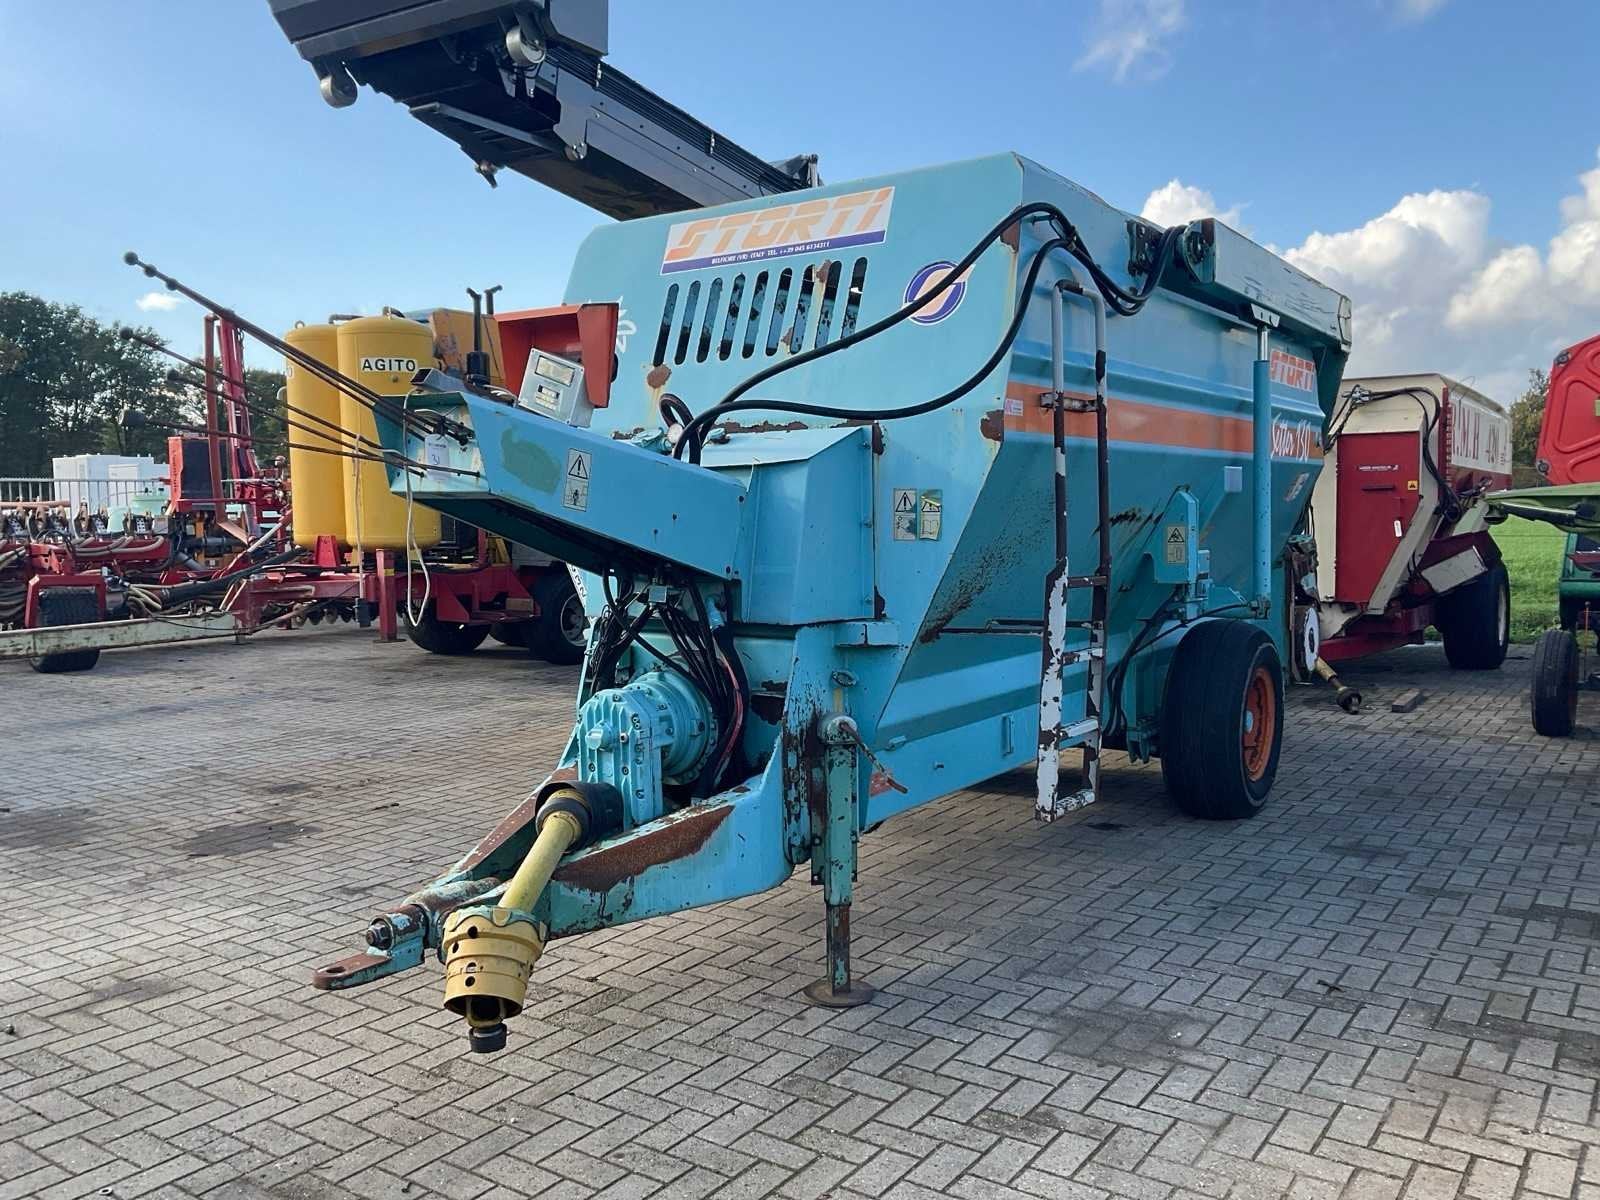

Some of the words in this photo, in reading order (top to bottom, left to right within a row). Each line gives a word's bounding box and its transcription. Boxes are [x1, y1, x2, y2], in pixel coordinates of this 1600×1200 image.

[665, 187, 894, 261] STORTI
[362, 358, 416, 372] AGITO
[1271, 350, 1315, 392] STORTI
